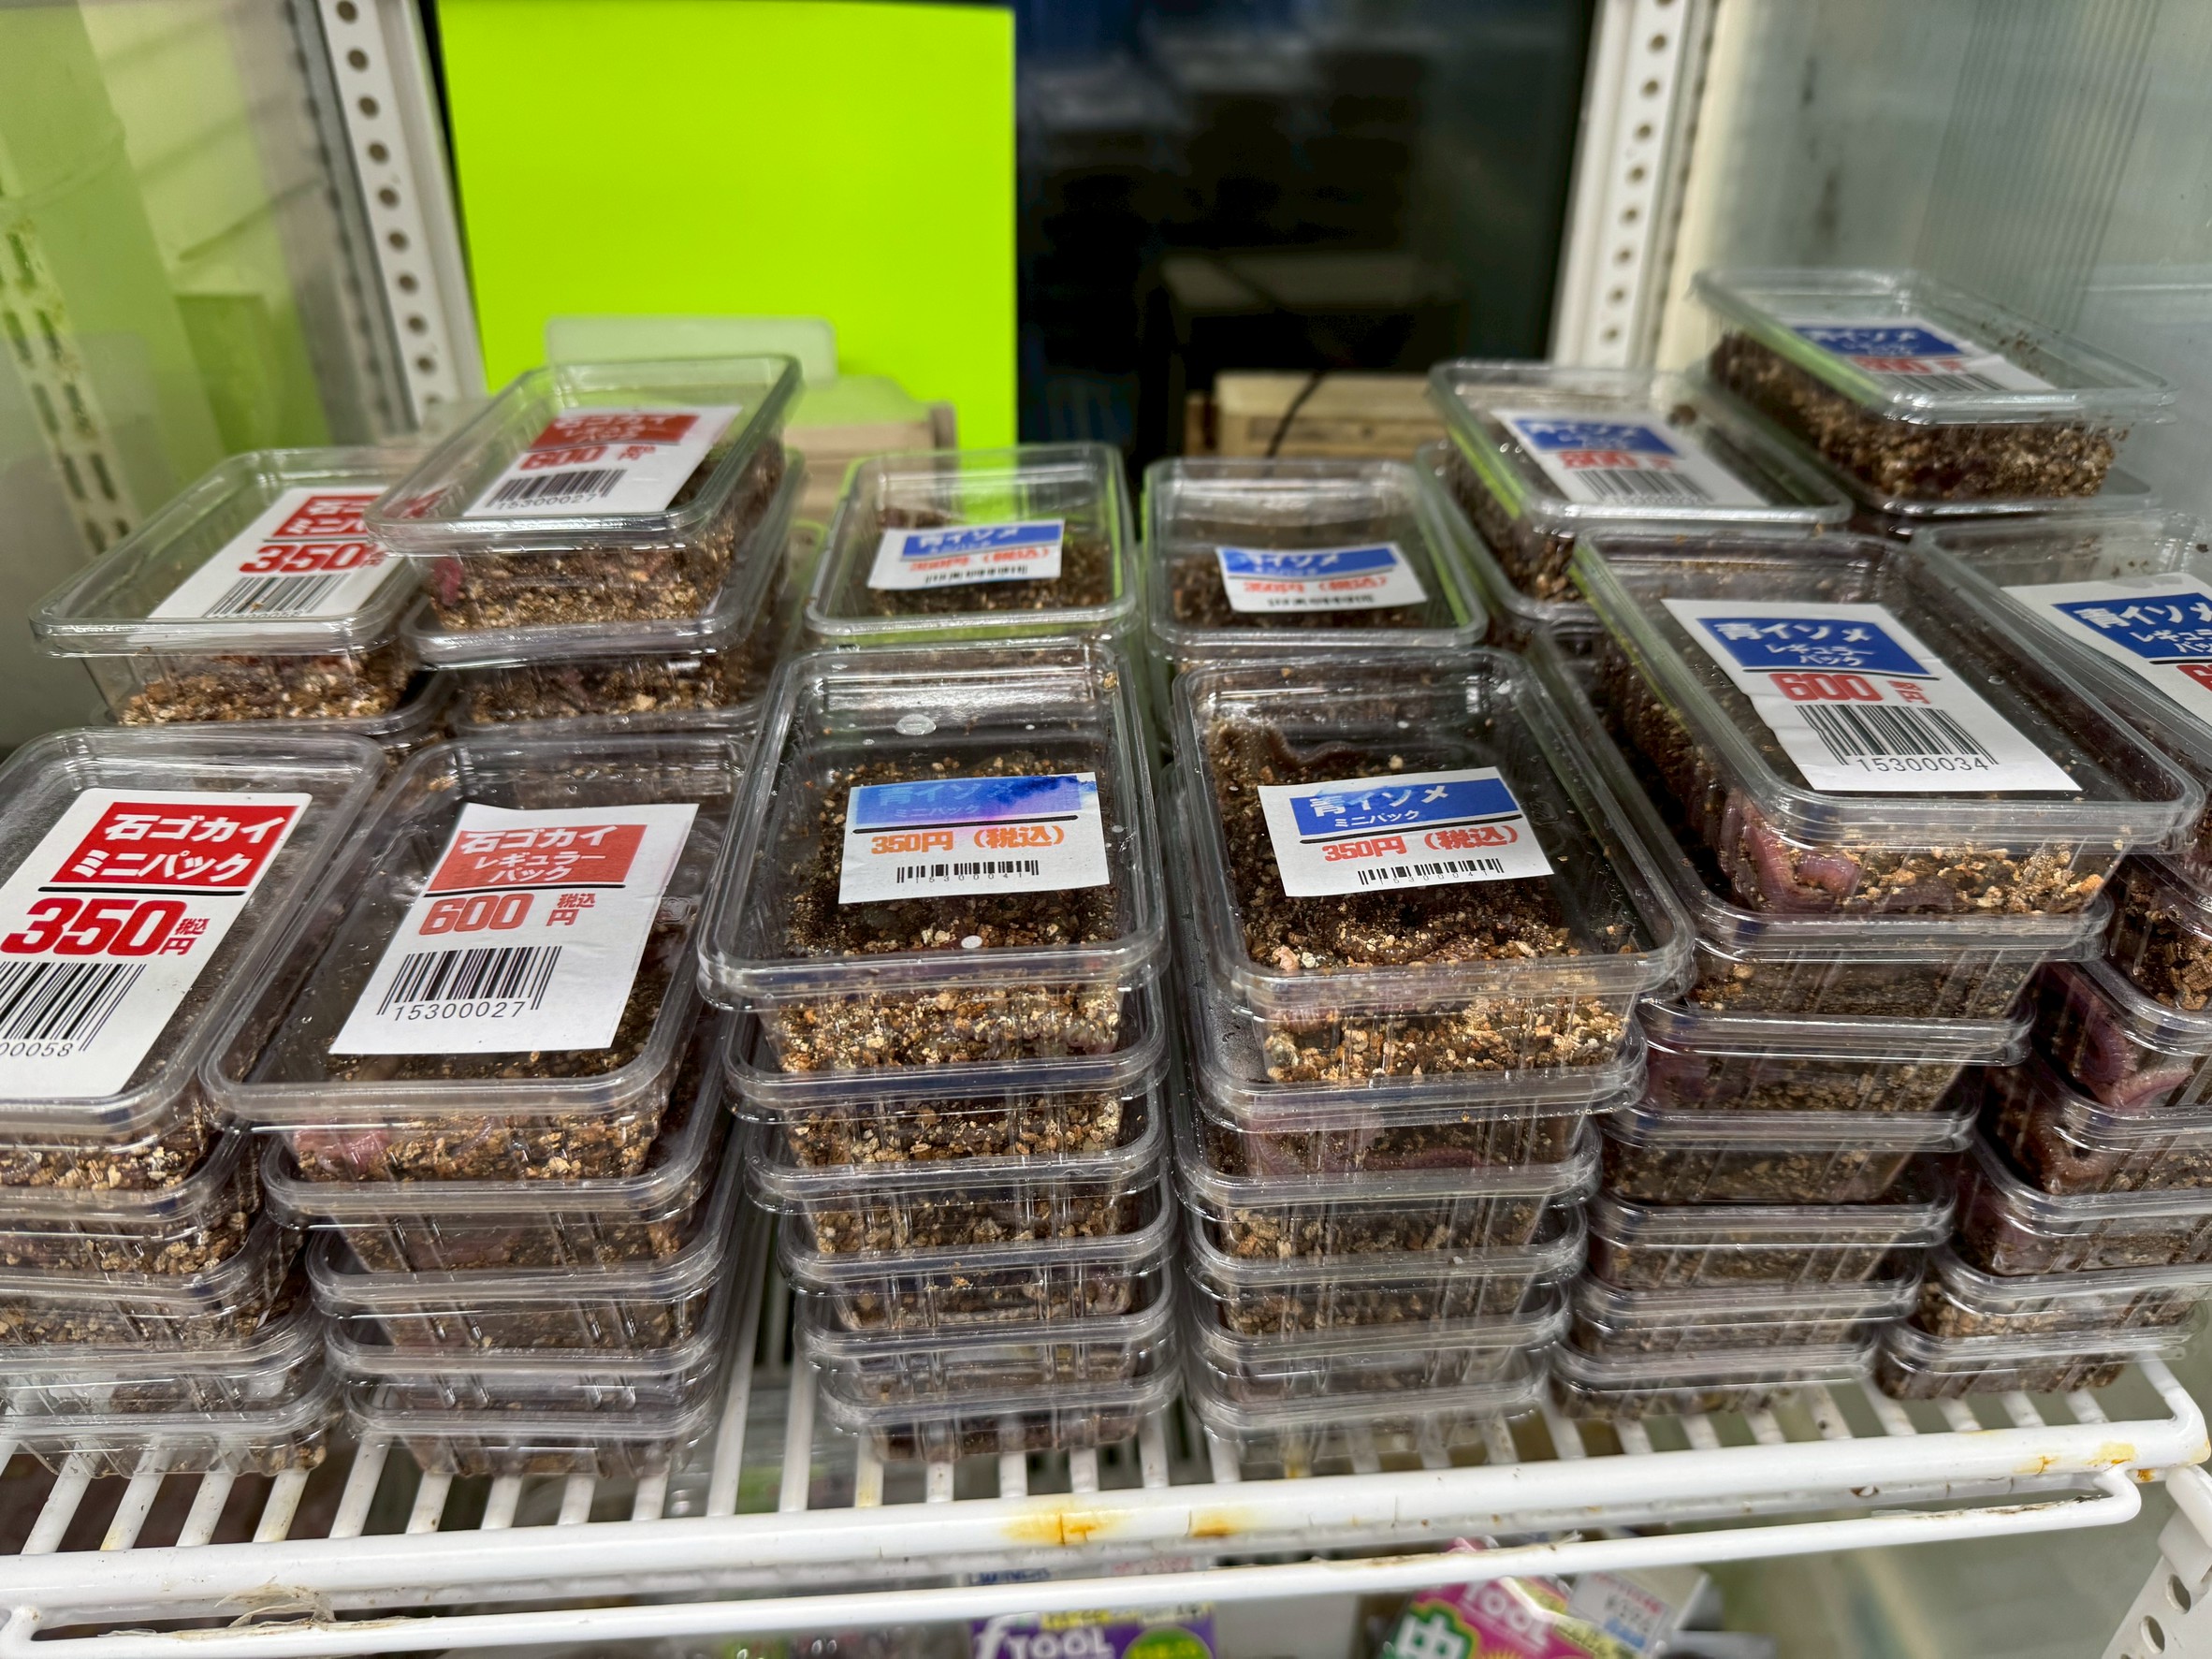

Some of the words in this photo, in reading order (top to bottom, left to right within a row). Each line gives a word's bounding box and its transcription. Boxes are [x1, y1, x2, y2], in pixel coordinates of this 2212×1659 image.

[239, 542, 364, 574] 350
[1713, 622, 1875, 643] 青イソメ
[1768, 673, 1885, 702] 600
[1855, 756, 1990, 773] 15300034
[105, 812, 286, 844] 石ゴカイ
[1334, 809, 1420, 828] ミニパック
[458, 824, 618, 855] 石ゴカイ
[870, 830, 953, 854] 350円
[1321, 836, 1407, 862] 350円
[71, 849, 254, 883] ミニパック
[474, 851, 607, 870] レギュラー
[488, 865, 574, 884] パック
[1, 896, 187, 956] 350
[158, 937, 197, 956] 円
[174, 917, 211, 936] 税込
[418, 893, 534, 936] 600
[546, 909, 579, 927] 円
[393, 1000, 527, 1022] 15300027
